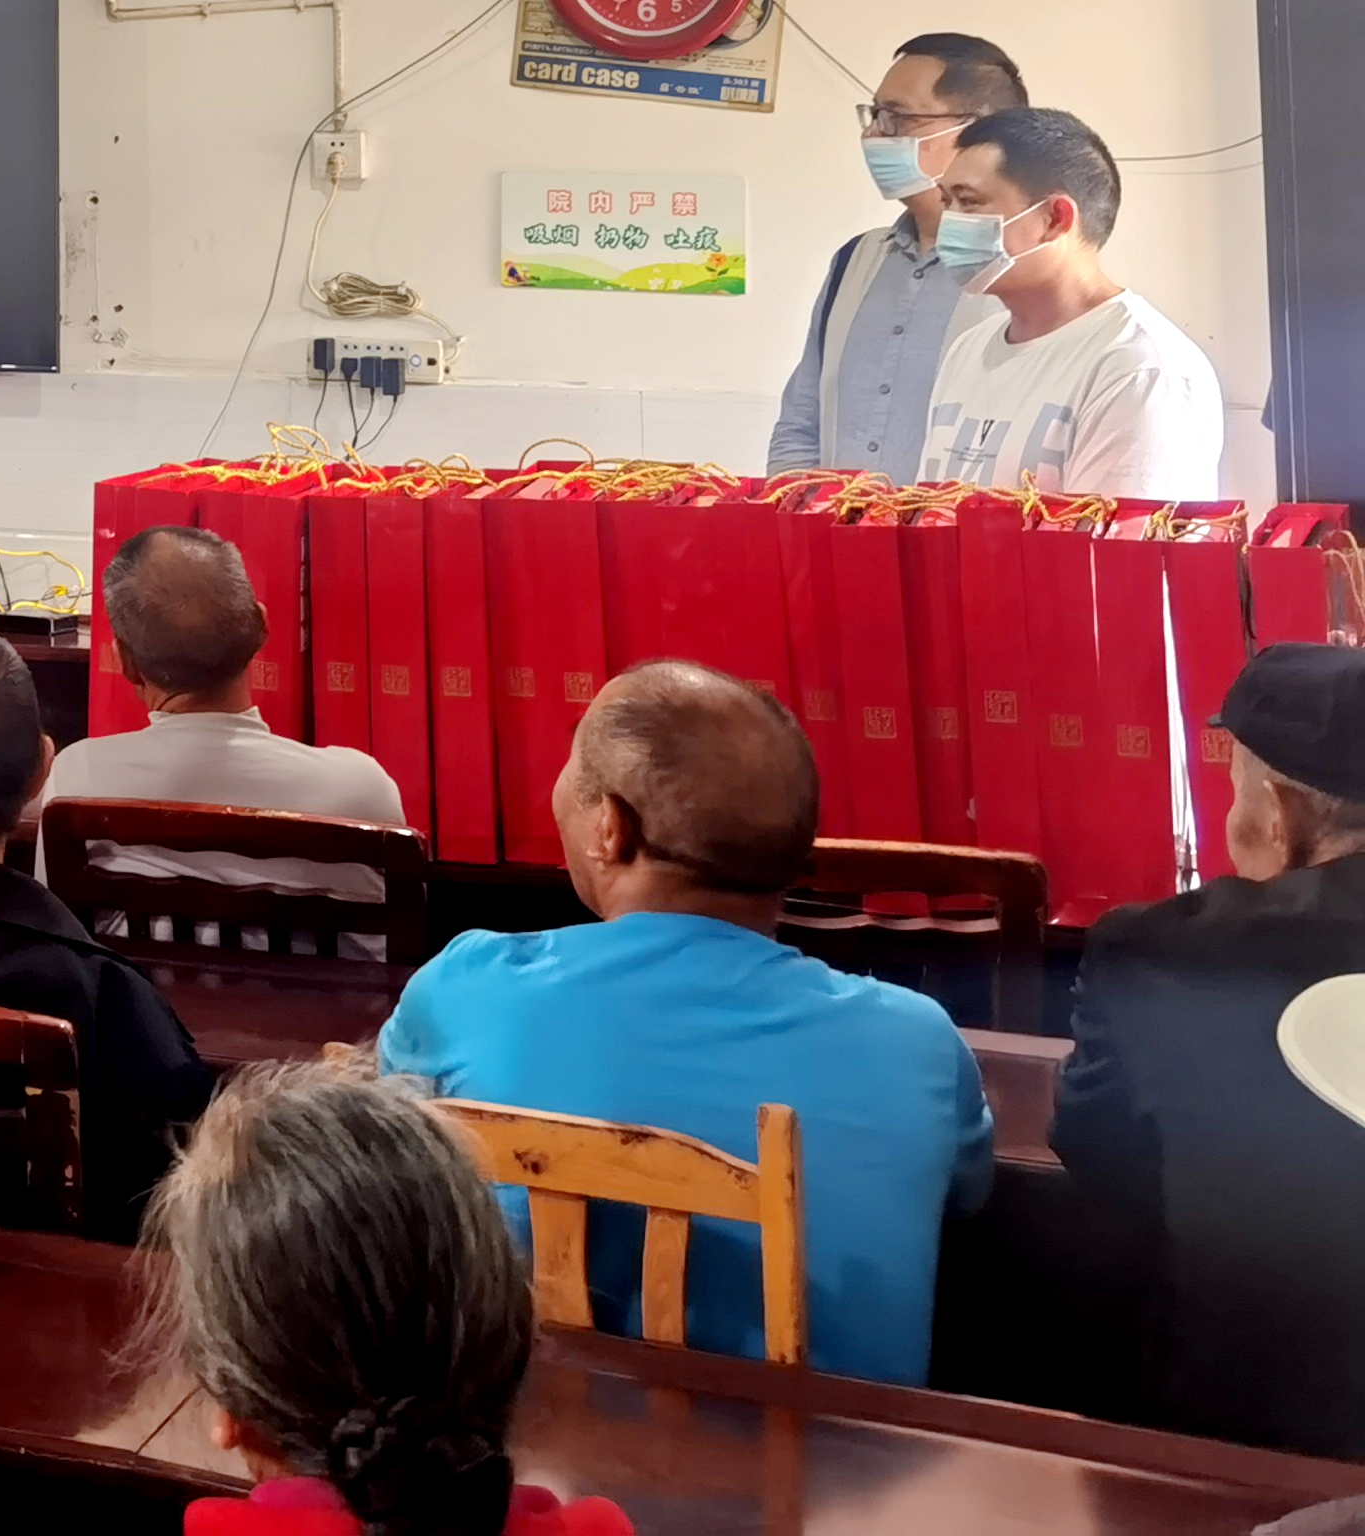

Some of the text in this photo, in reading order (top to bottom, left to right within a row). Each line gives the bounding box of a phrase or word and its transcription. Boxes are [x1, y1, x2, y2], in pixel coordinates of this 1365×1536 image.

[523, 60, 578, 82] card
[581, 65, 640, 89] case
[547, 189, 698, 216] 院内严禁
[523, 223, 722, 252] 吸烟 扔物 吐痰
